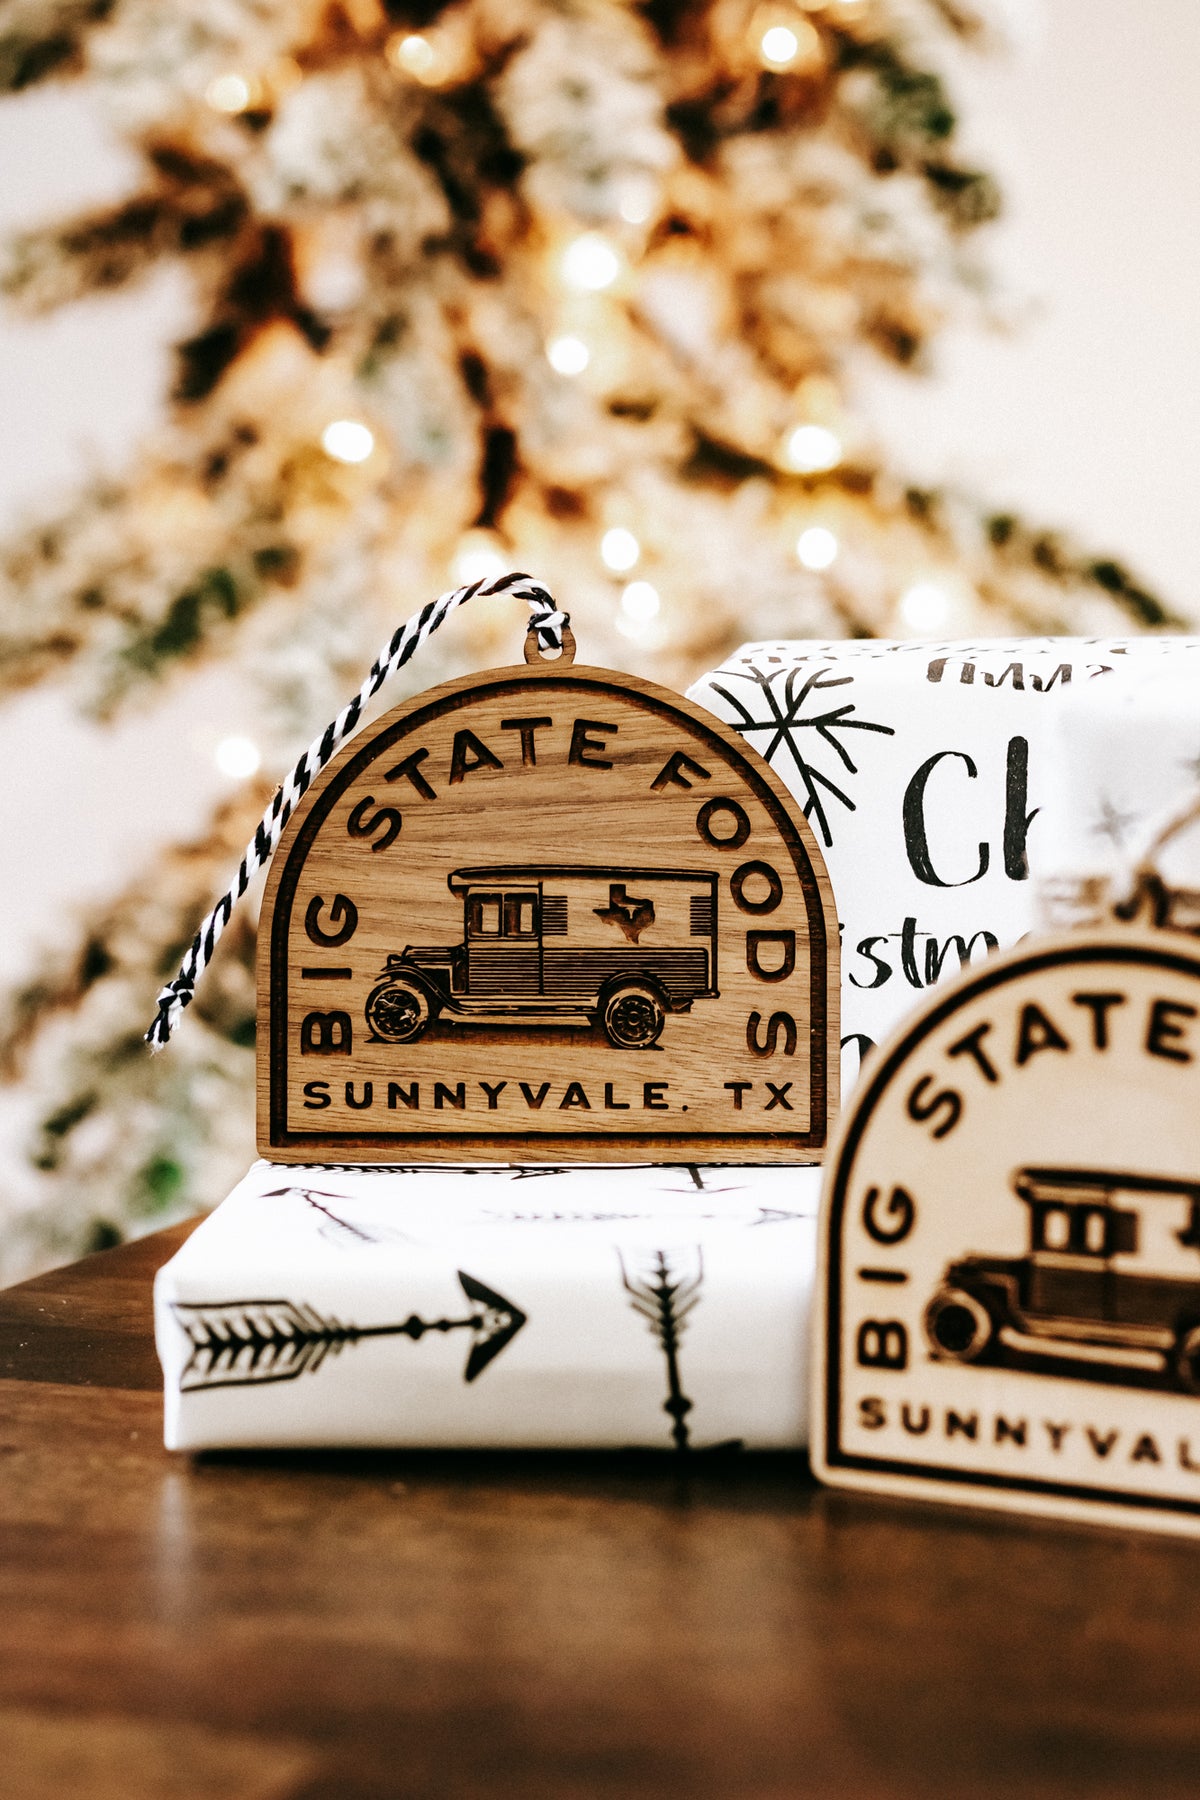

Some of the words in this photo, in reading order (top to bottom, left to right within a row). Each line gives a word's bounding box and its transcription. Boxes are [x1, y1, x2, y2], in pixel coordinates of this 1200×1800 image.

[302, 894, 359, 1056] BIG
[347, 716, 618, 852] STATE
[650, 751, 797, 1059] FOODS
[723, 1081, 794, 1111] TX
[858, 1185, 917, 1370] BIG
[907, 993, 1197, 1139] STATE
